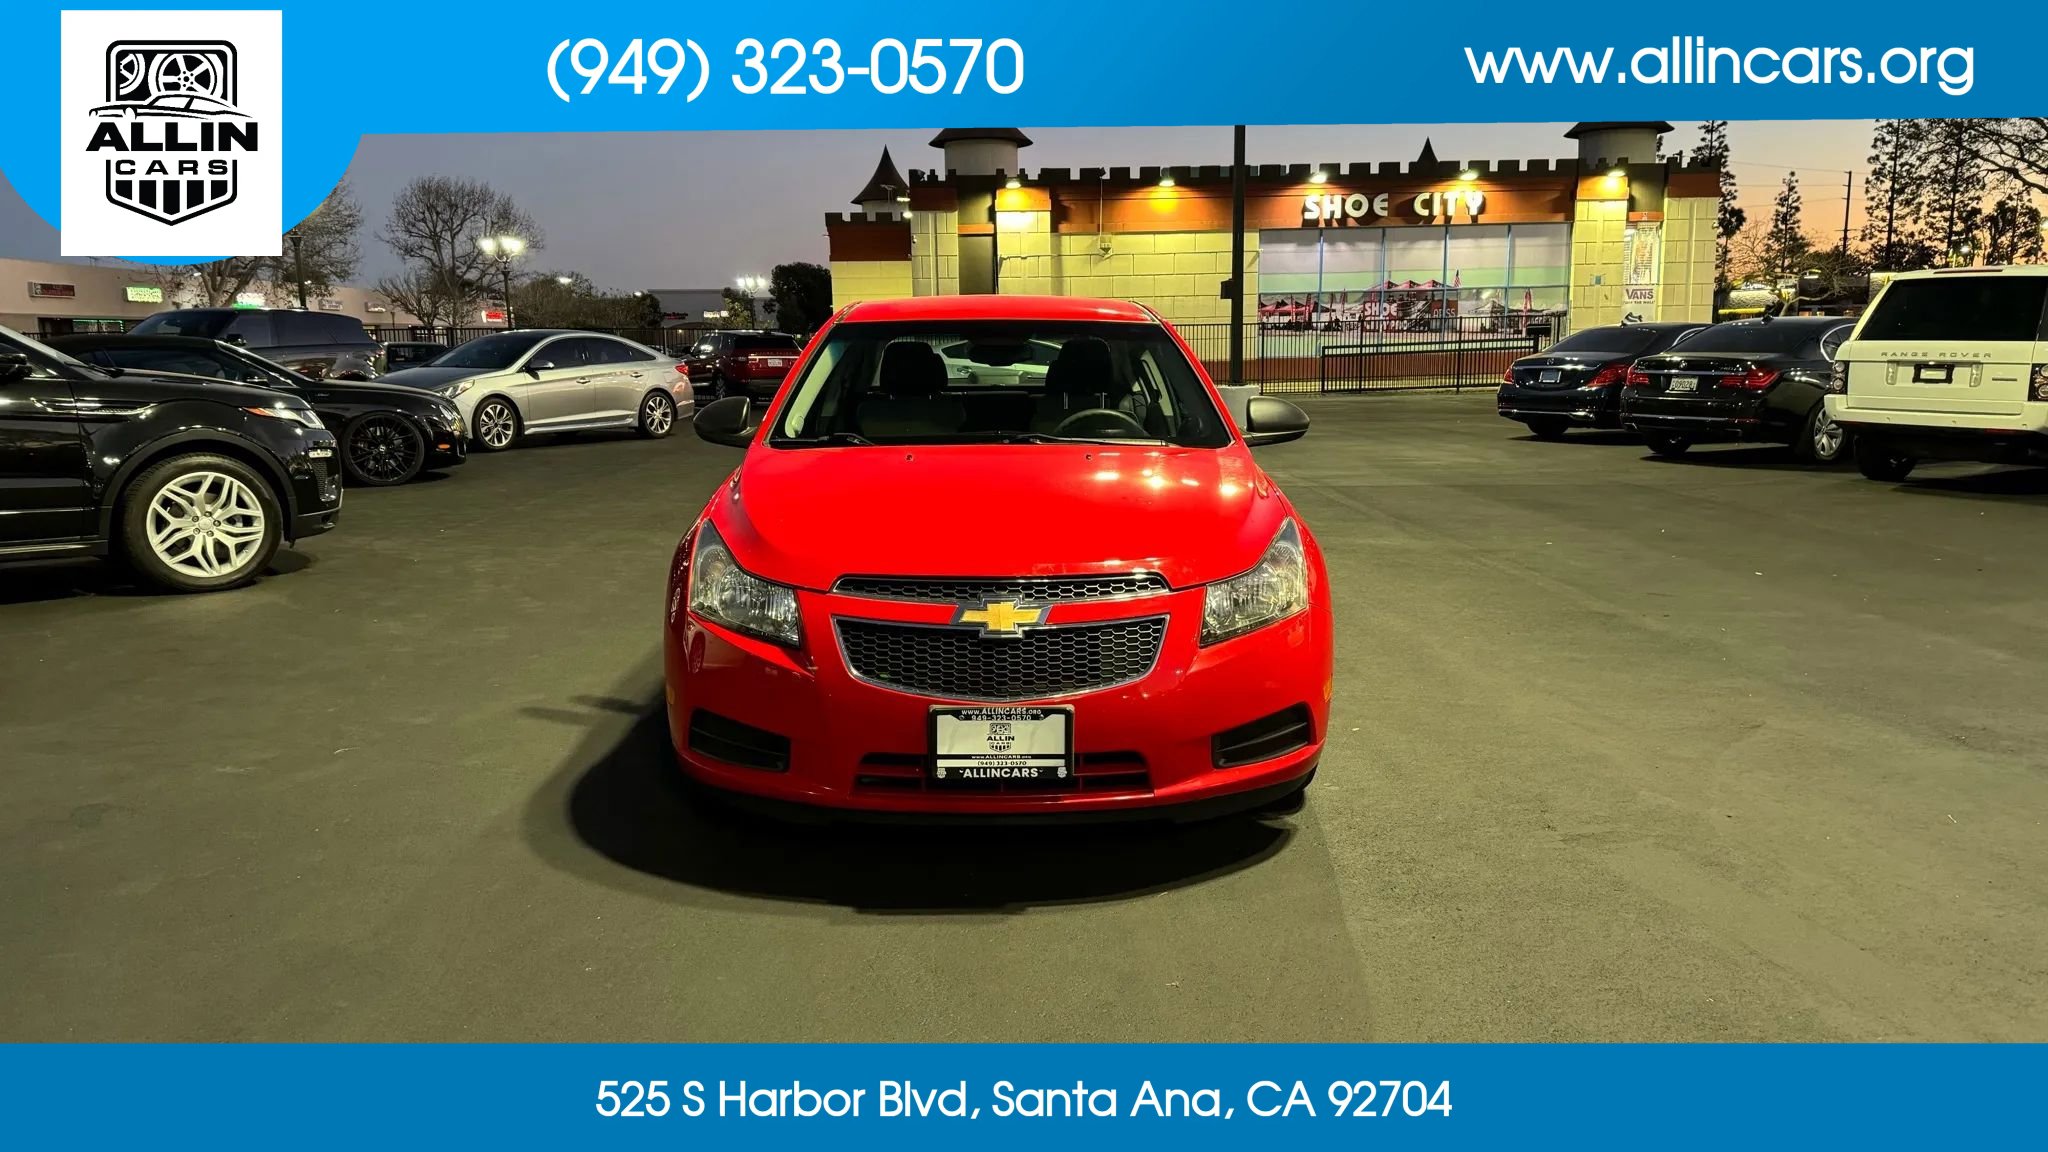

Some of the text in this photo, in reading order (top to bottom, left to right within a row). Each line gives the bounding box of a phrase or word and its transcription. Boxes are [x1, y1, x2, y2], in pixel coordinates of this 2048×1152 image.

[1303, 191, 1484, 219] SHOE CITY
[1625, 288, 1654, 300] VANS
[1364, 301, 1398, 316] SHOE
